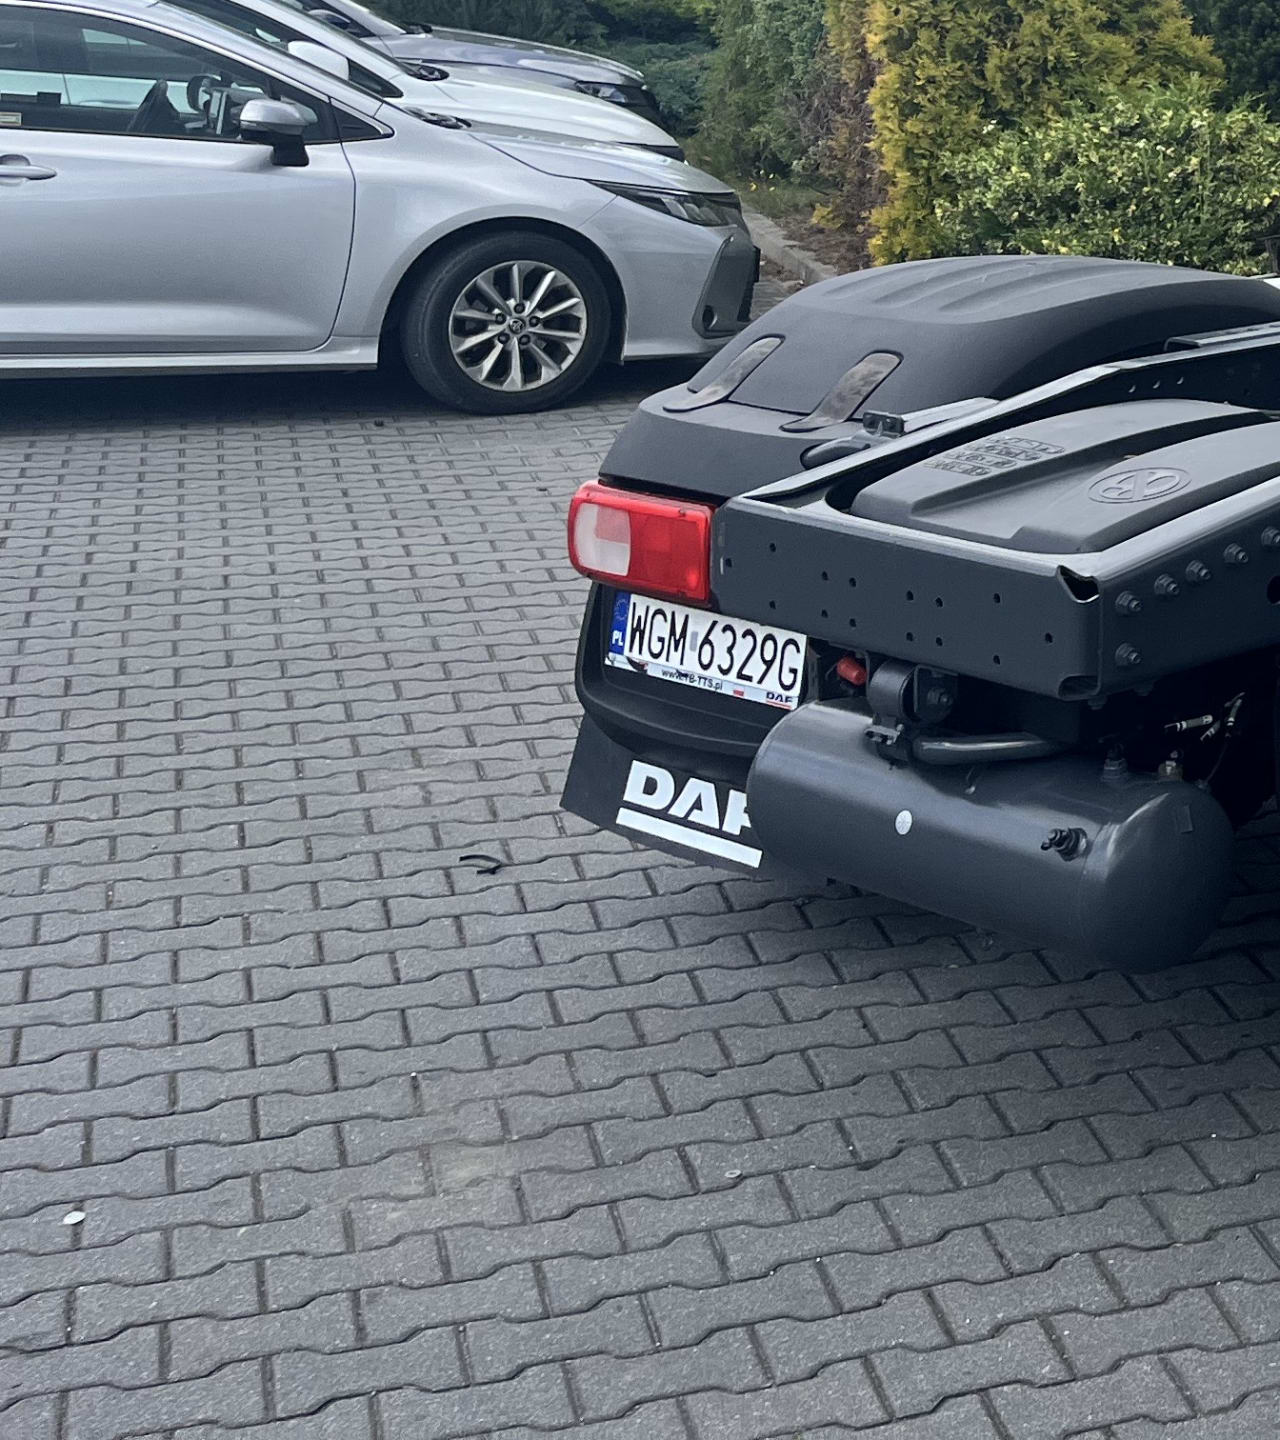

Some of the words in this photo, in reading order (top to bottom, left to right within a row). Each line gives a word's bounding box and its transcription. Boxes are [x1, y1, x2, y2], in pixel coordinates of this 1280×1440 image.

[612, 630, 624, 646] PL
[628, 602, 689, 666] WGM
[698, 620, 801, 691] 6329G
